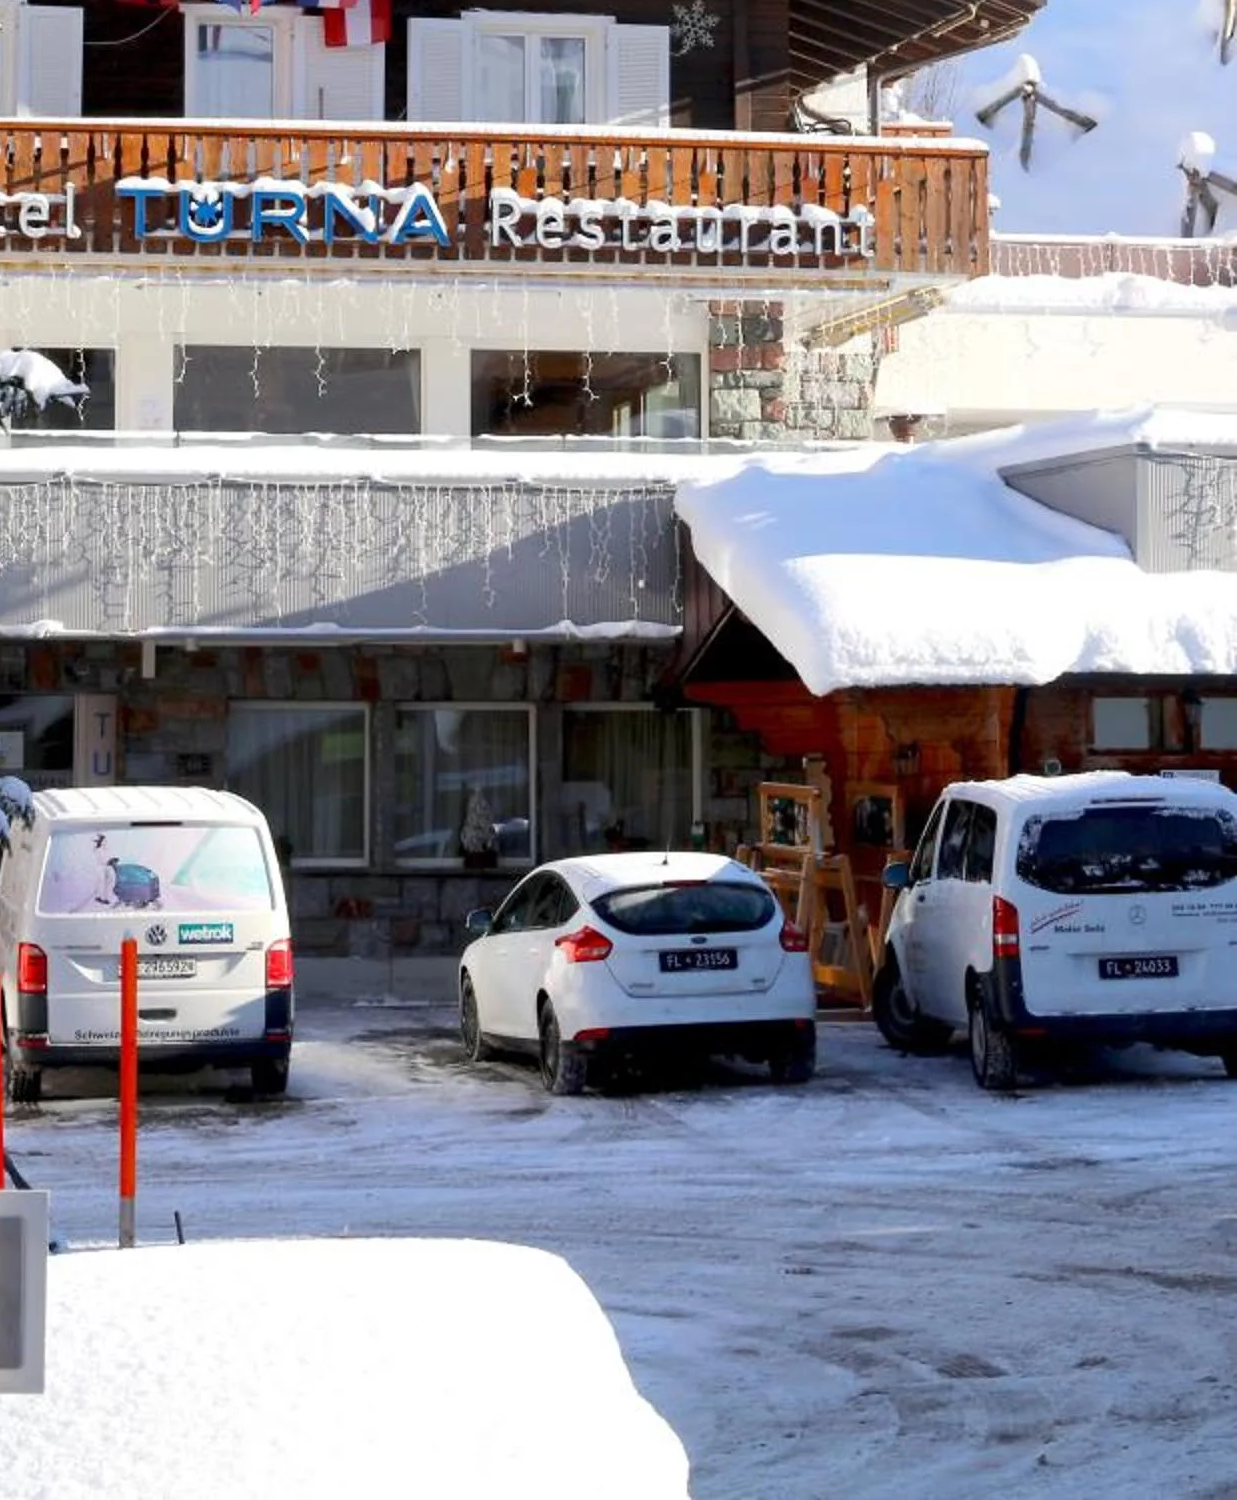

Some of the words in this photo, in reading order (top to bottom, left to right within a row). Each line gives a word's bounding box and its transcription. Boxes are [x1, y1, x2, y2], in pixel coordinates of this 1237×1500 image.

[117, 184, 451, 248] TURNA
[490, 194, 876, 258] Restaurant
[180, 925, 232, 941] wetrok
[74, 1029, 123, 1041] Schweiz
